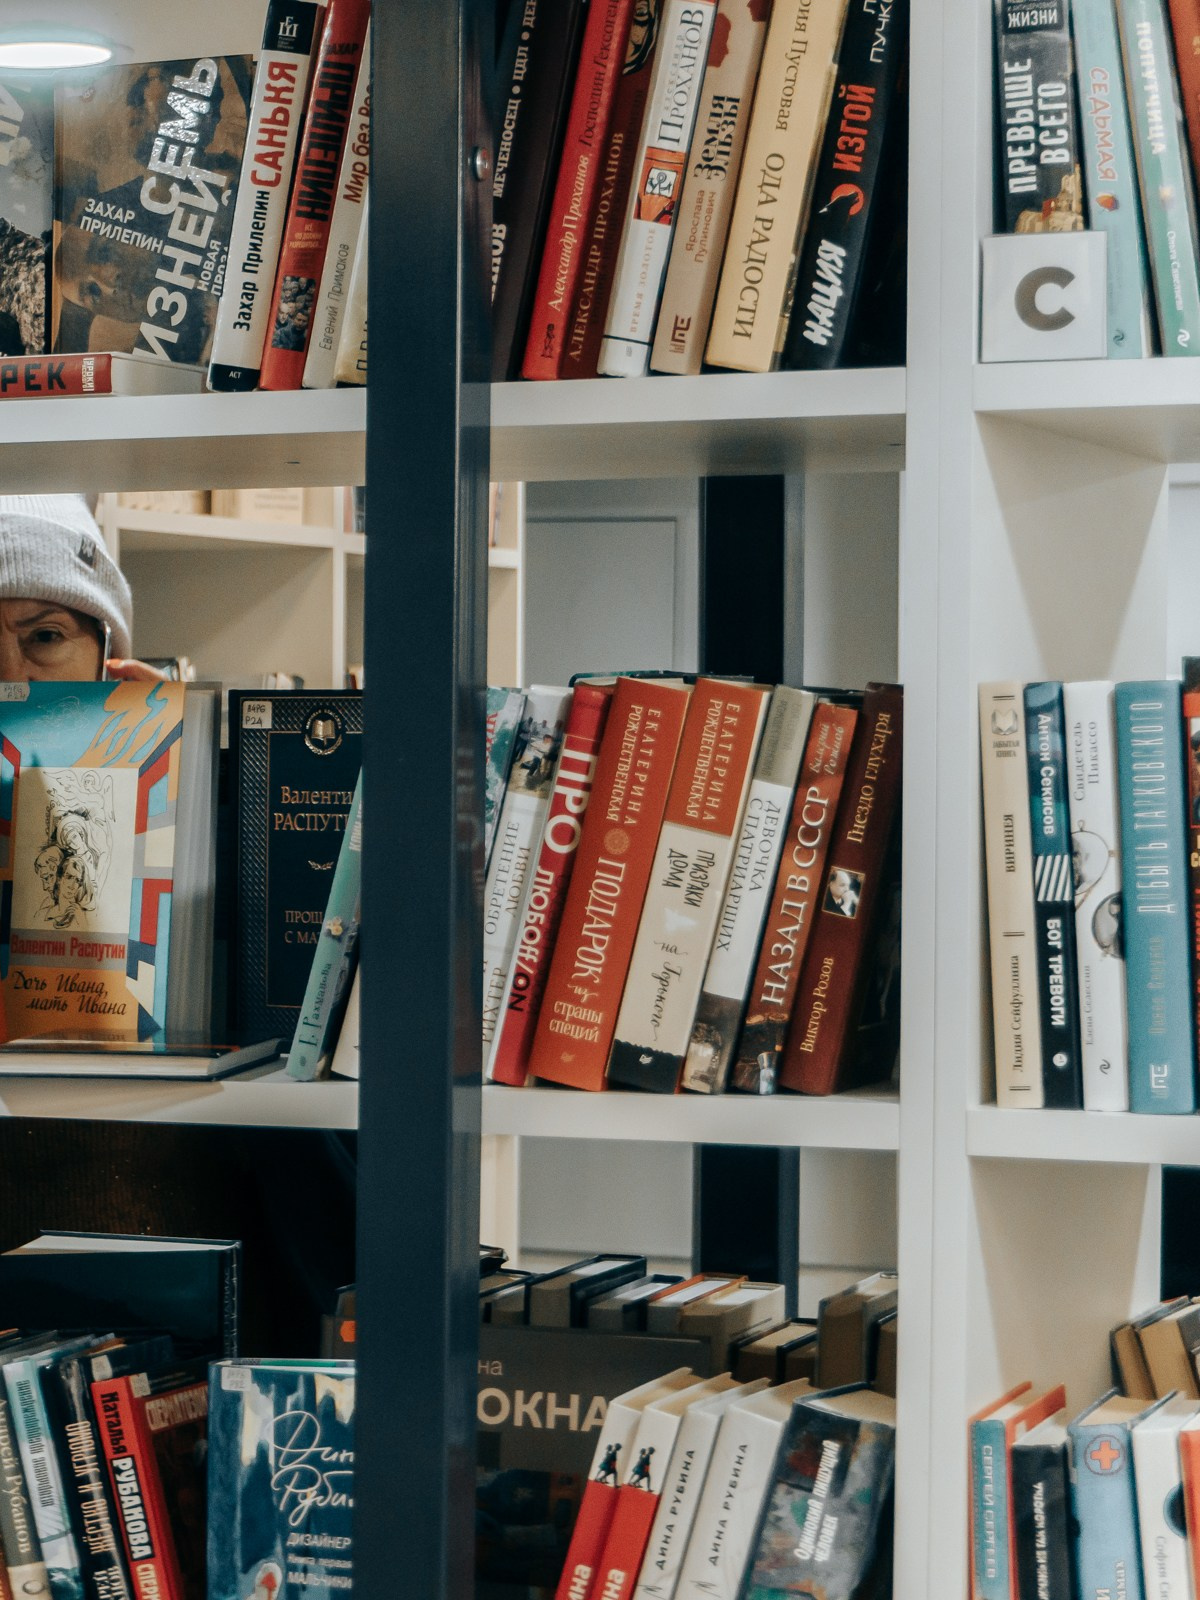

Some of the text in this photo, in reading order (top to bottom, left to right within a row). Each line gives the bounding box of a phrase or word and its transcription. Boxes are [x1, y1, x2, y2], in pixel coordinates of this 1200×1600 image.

[1008, 8, 1059, 29] ЖИЗНИ
[140, 58, 218, 216] СЕМЬ
[250, 60, 299, 188] САНЬКЯ
[295, 60, 356, 222] ПРИЛЕПИН
[492, 45, 529, 200] МЕЧЕНОСЕЦ ЦДЛ
[1002, 57, 1038, 195] ПРЕВЫШЕ
[1036, 80, 1071, 165] ВСЕГО
[1088, 66, 1117, 182] СЕДЬМАЯ
[1135, 20, 1166, 156] ПОПУТЧИЦА
[79, 215, 164, 254] ПРИЛЕПИН
[85, 198, 136, 224] ЗАХАР
[241, 189, 271, 275] Прилепин
[569, 132, 624, 362] АЛЕКСАНДР ПРОХАНОВ
[686, 189, 706, 254] Ярослава
[694, 190, 717, 264] Пулинович
[733, 151, 786, 341] ОДА РАДОСТИ
[802, 84, 877, 347] НАЦИЯ ИЗГОЙ
[197, 240, 222, 292] НОВАЯ
[232, 277, 257, 332] Захар
[319, 243, 349, 351] Евгений Примаков
[1013, 265, 1076, 333] С
[1, 361, 67, 393] РЕК
[228, 370, 242, 379] АСТ
[280, 786, 354, 805] Валенти
[544, 747, 598, 855] ПРО
[605, 704, 644, 822] РОЖДЕСТВЕНСКАЯ
[623, 708, 662, 826] ЕКАТЕРИНА
[684, 698, 723, 819] РОЖДЕСТВЕНСКАЯ
[702, 702, 741, 822] ЕКАТЕРИНА
[1037, 713, 1057, 837] Антон Секисов
[1072, 720, 1087, 802] Свидетель
[1086, 720, 1100, 786] Пикассо
[748, 800, 782, 893] ДЕВОЧКА
[1003, 813, 1017, 874] ВИРИНЕЯ
[1129, 700, 1177, 915] ДОБЫТЬ ТАРКОВСКОГО
[484, 819, 521, 937] ОБРЕТЕНИЕ
[505, 846, 532, 919] ЛЮБВИ
[570, 856, 627, 987] ПОДАРОК
[715, 811, 753, 953] ПАТРИАРШИХ
[761, 785, 830, 1006] НАЗАД В СССР
[10, 936, 126, 961] Валентин Распутин
[12, 970, 109, 998] Дочь Ивана,
[1046, 919, 1066, 1026] БОГ ТРЕВОГИ
[26, 994, 127, 1017] мать Ивана
[548, 1018, 600, 1044] специй
[552, 1000, 604, 1024] страны
[799, 956, 835, 1055] Виктор Розов
[1009, 955, 1024, 1073] Лидия Сейфуллина
[476, 1387, 610, 1433] ОКНА
[5, 1473, 31, 1555] Рубанов
[100, 1390, 155, 1561] Наталья РУБАНОВА
[654, 1449, 695, 1570] ДИНА РУБИНА
[708, 1443, 748, 1566] ДИНА РУБИНА
[982, 1444, 997, 1579] СЕРГЕЙ СЕРГЕЕВ
[286, 1532, 351, 1549] ДИЗАЙНЕР
